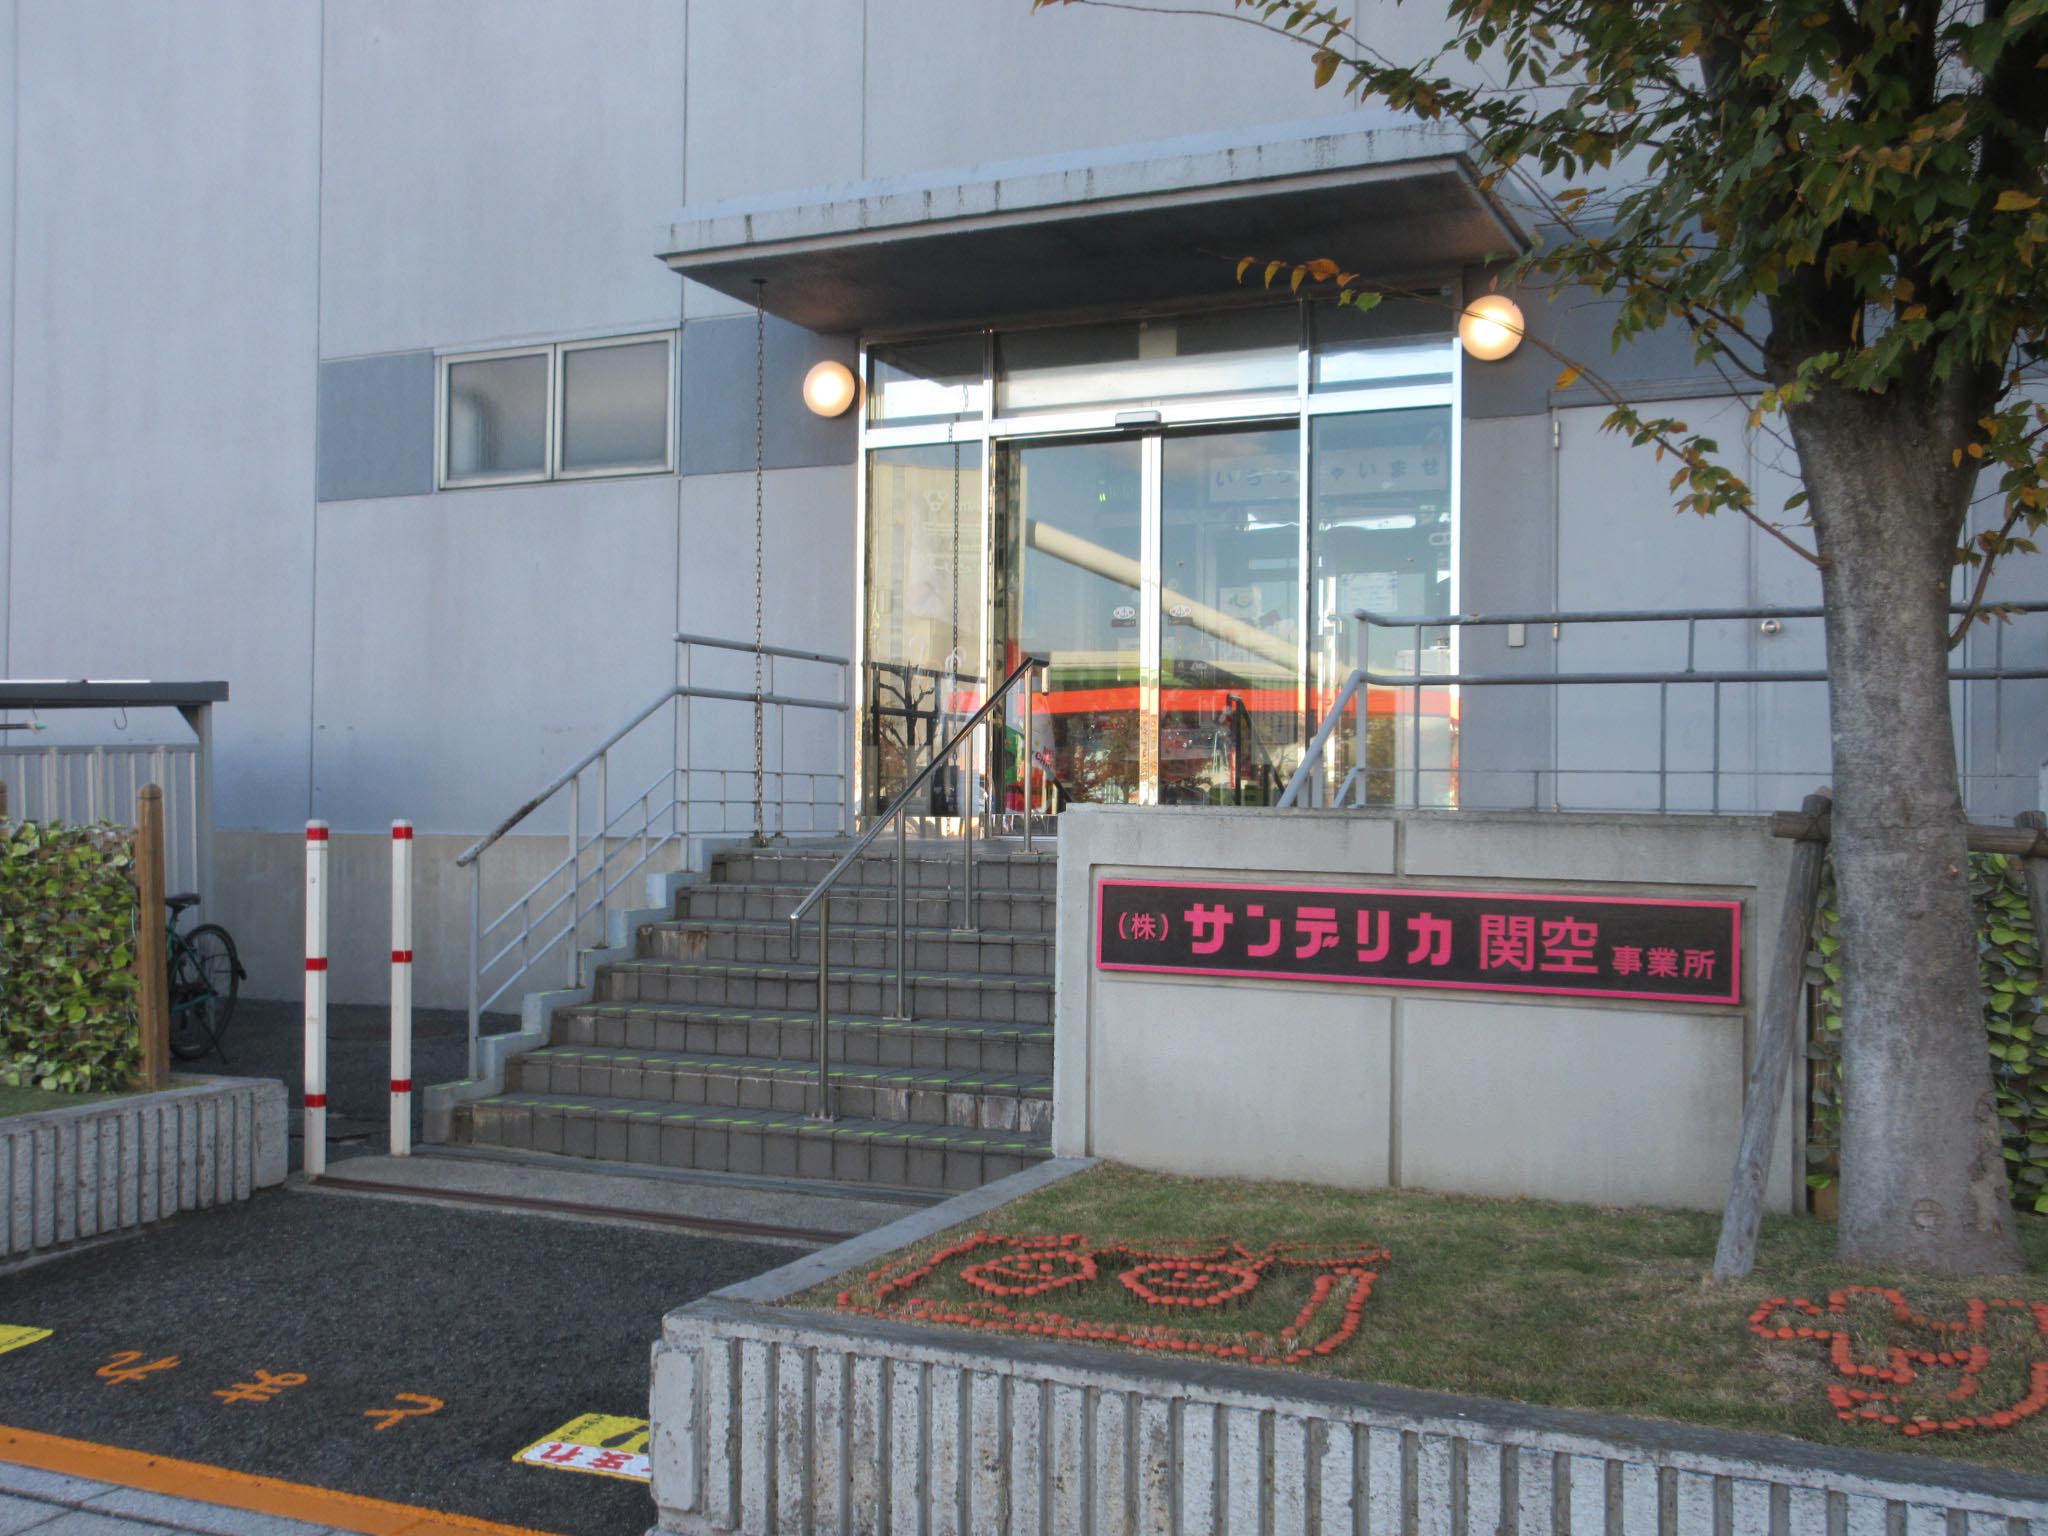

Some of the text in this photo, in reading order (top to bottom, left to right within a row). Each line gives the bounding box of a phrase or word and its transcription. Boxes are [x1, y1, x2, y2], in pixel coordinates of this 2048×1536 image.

[1183, 902, 1453, 967] サンデリカ
[1479, 914, 1599, 974] 関空
[1611, 945, 1717, 980] 事業所
[540, 1443, 651, 1473] まれ
